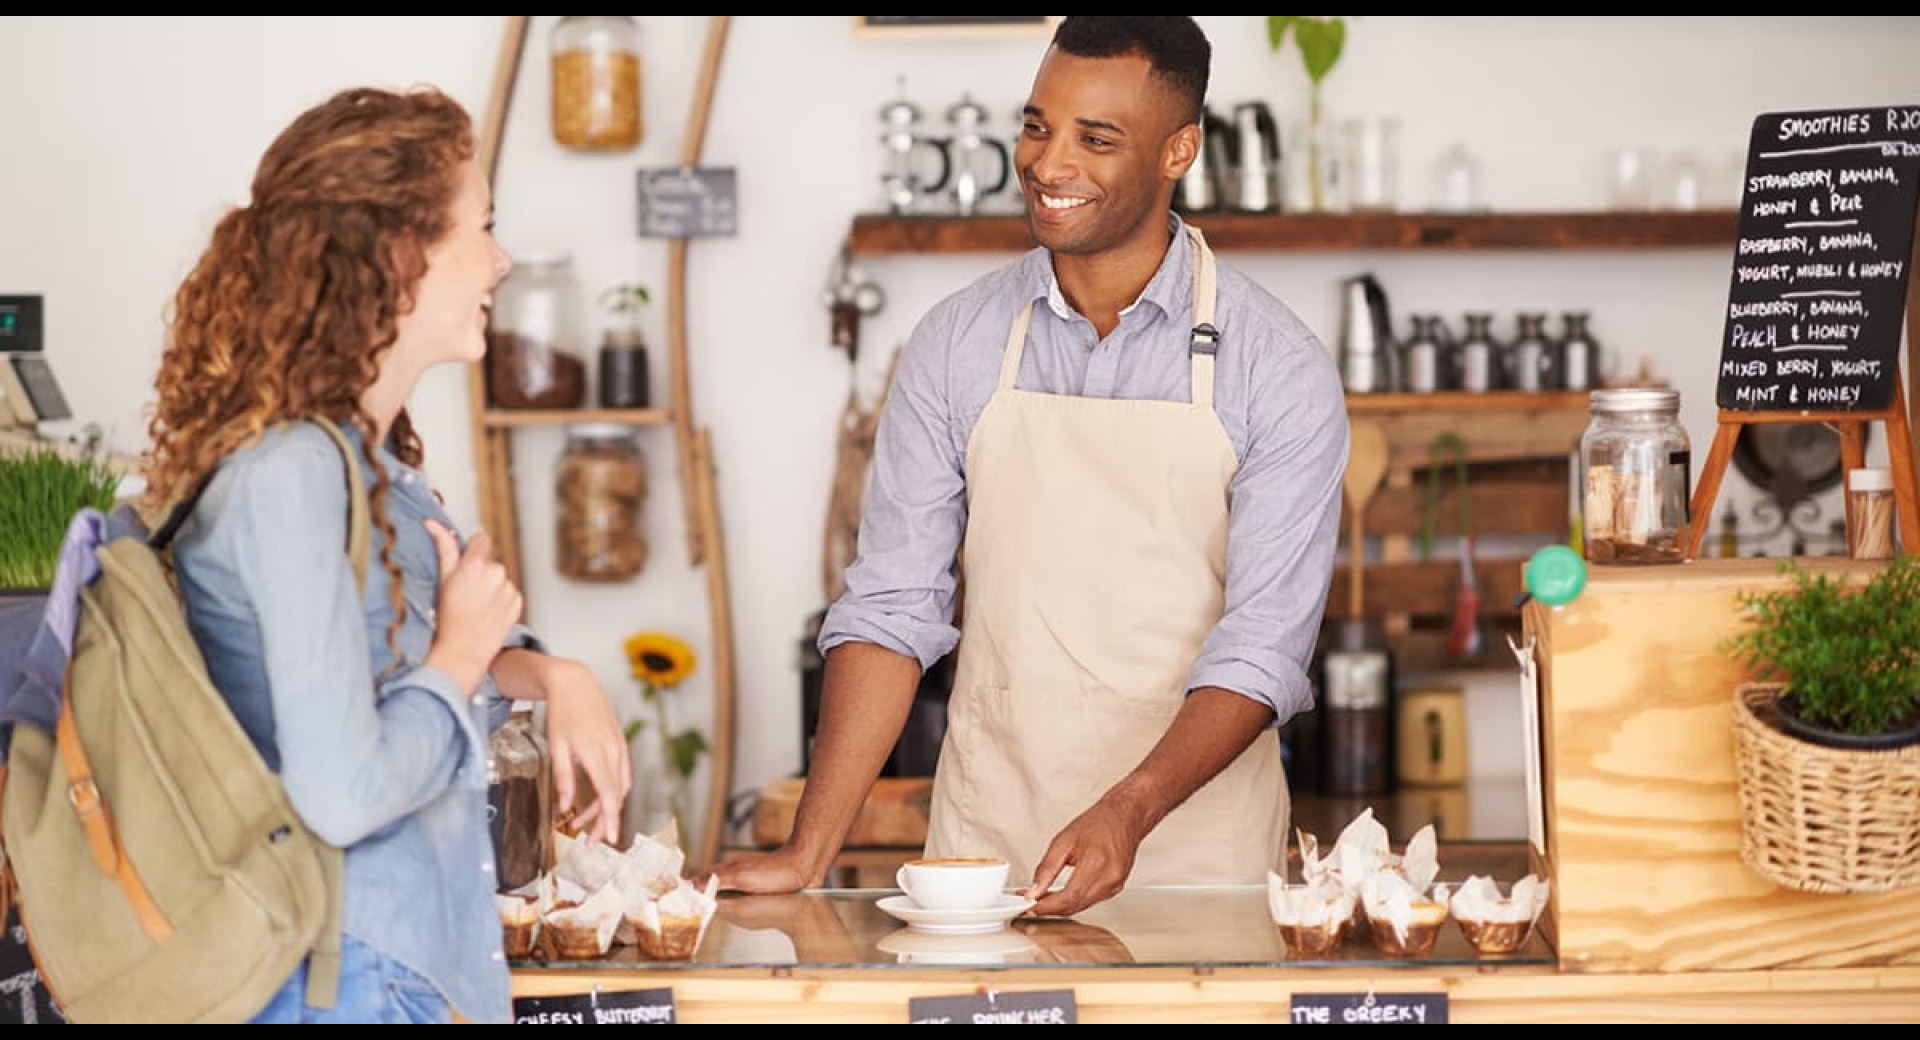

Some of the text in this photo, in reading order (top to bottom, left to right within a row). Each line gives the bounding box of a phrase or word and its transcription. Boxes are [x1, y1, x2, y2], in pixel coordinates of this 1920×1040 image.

[1779, 114, 1870, 139] SMOOTHIES
[1749, 166, 1899, 192] STRAWBERRY, BANANA,
[1753, 199, 1797, 216] HONEY
[1739, 231, 1878, 256] RASPBERRY, BANANA,
[1738, 263, 1794, 284] YOGURT,
[1797, 263, 1842, 278] MUESLI
[1860, 260, 1903, 279] HONEY
[1730, 299, 1869, 321] BLUEBERRY, BANANA,
[1731, 324, 1776, 348] PEACH
[1807, 324, 1860, 340] HONEY
[1721, 360, 1767, 378] MIXED
[1831, 359, 1881, 379] YOGURT,
[1736, 385, 1780, 402] MINT
[1807, 384, 1860, 403] HONEY
[1292, 1006, 1331, 1024] THE
